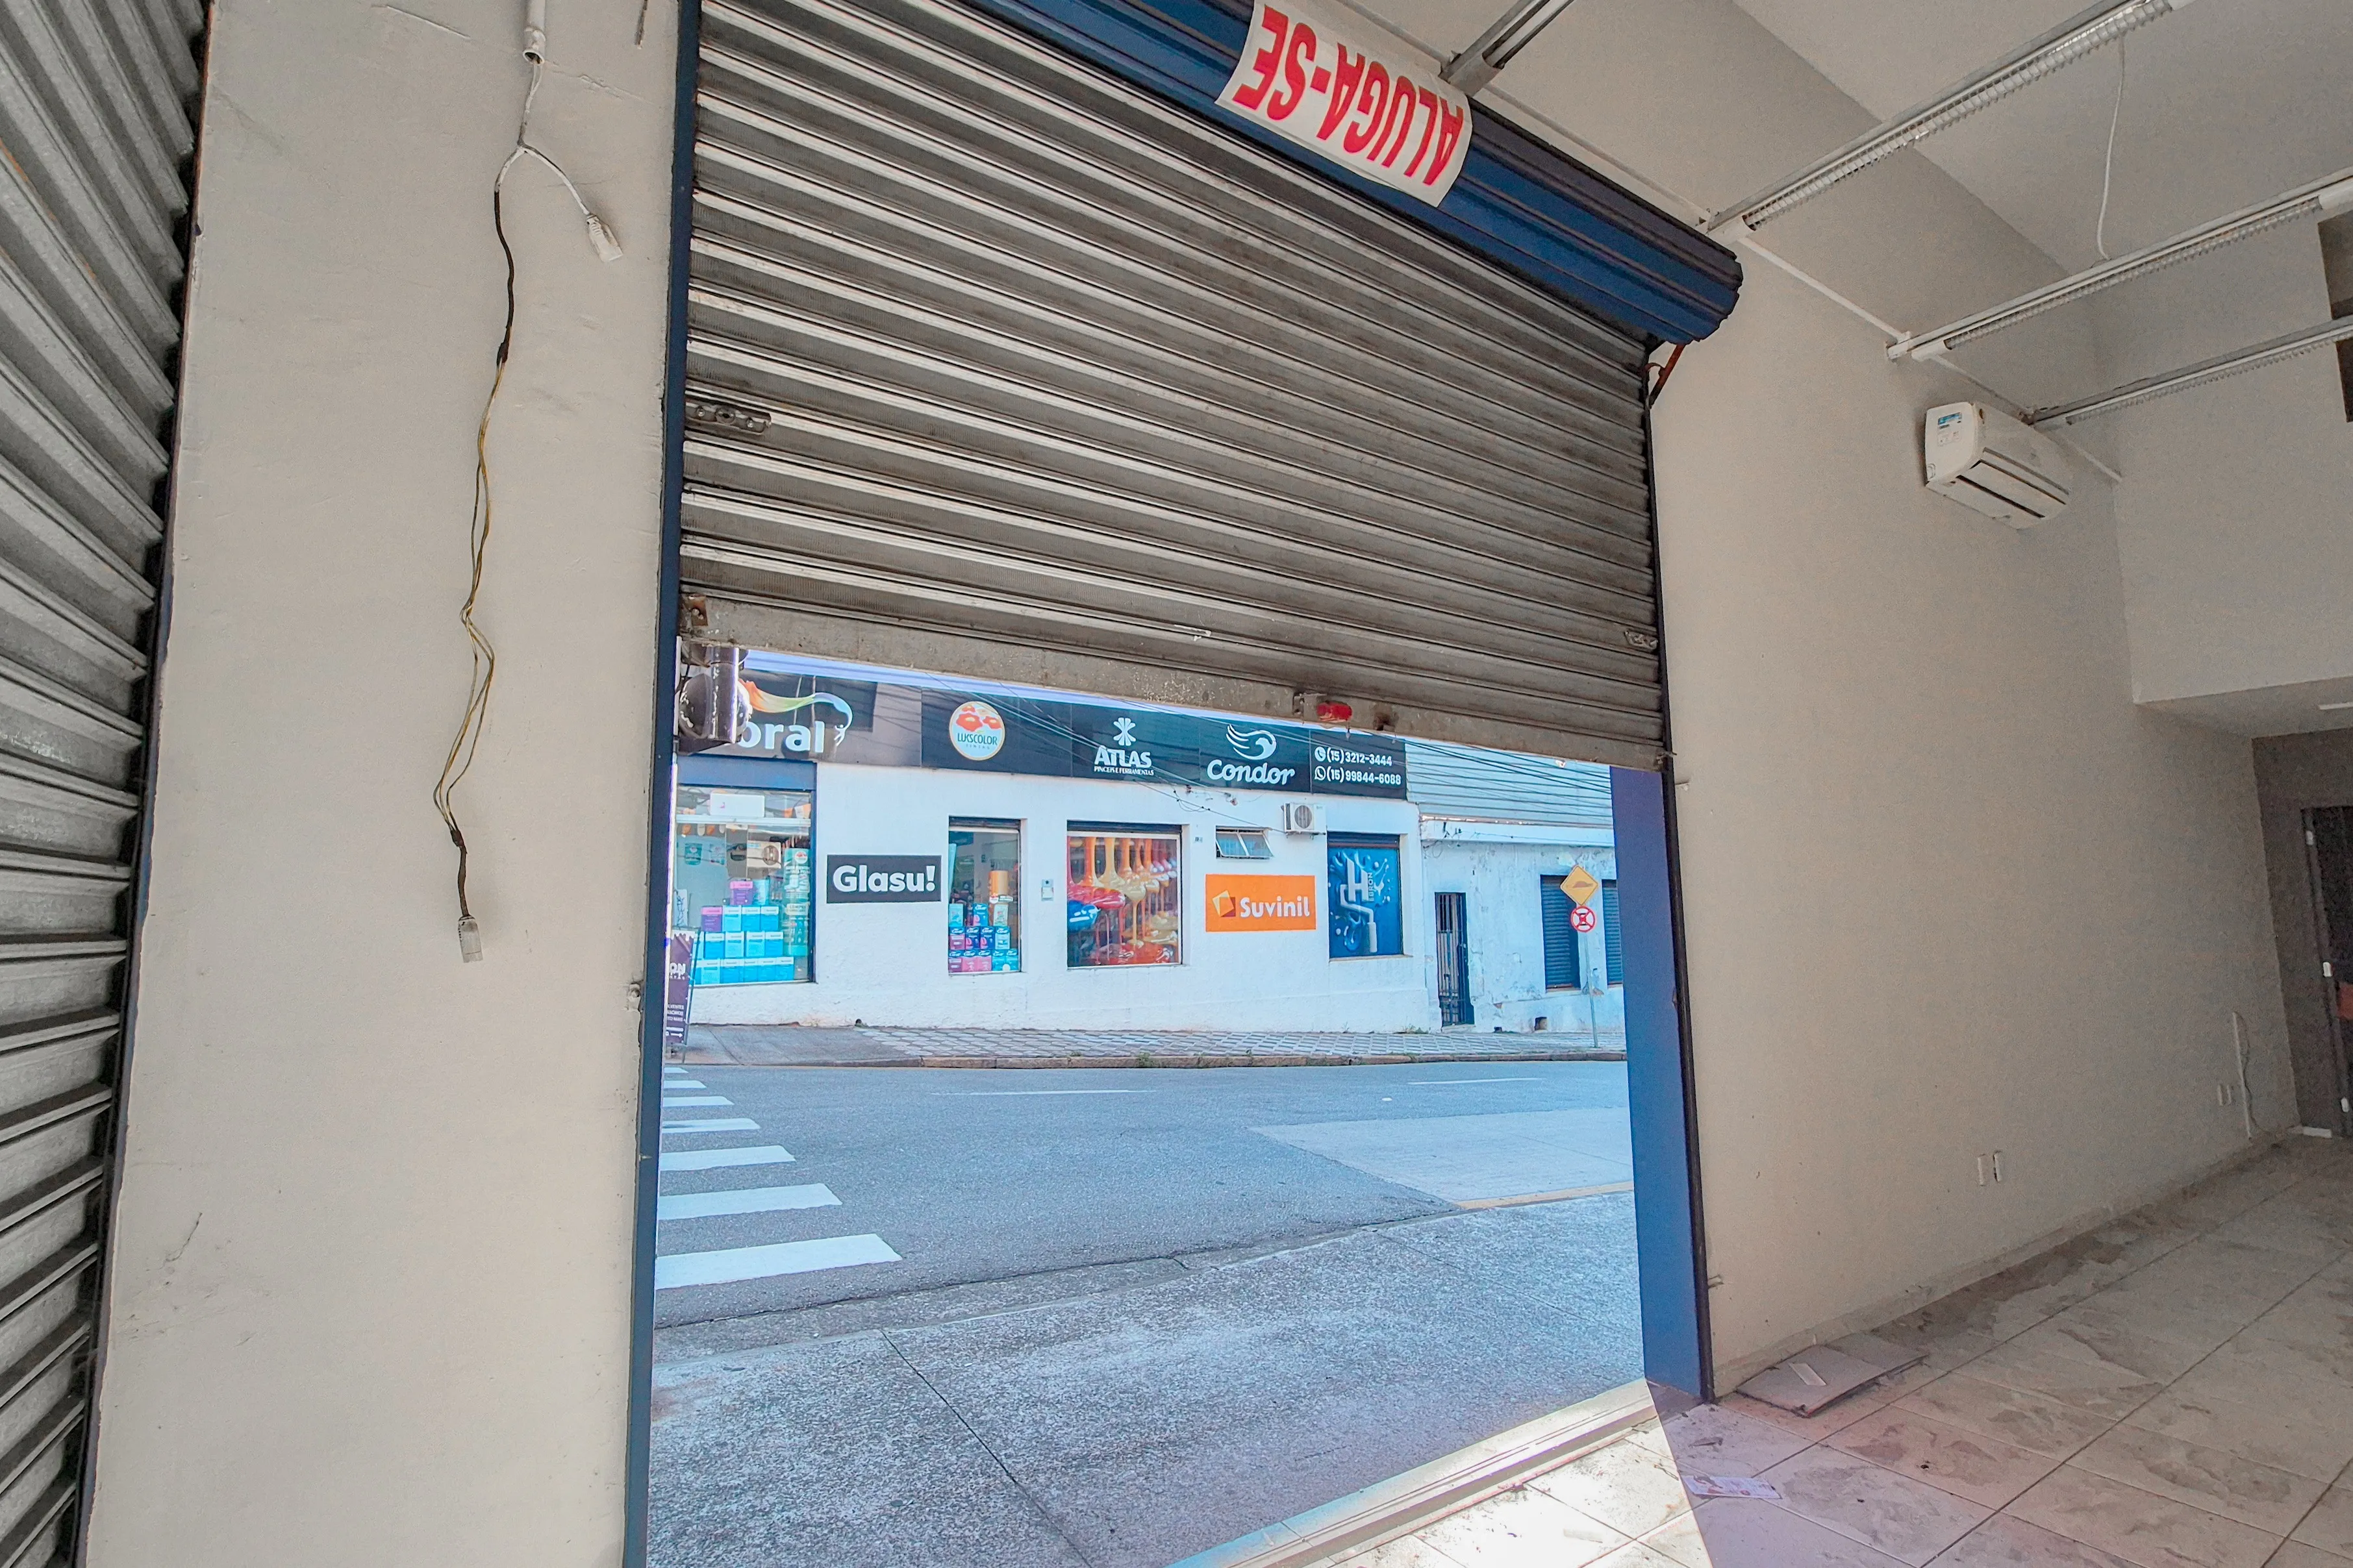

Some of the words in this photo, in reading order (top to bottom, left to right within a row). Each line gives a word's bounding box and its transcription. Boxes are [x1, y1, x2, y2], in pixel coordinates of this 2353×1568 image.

[1232, 4, 1464, 186] ALUGA-SE
[735, 720, 825, 753] oral
[957, 732, 998, 745] LUKSCOLOR
[1094, 745, 1152, 768] ATLAS
[1207, 759, 1296, 785] Condor
[833, 865, 936, 892] Glasu!
[1240, 895, 1310, 917] Suvinil
